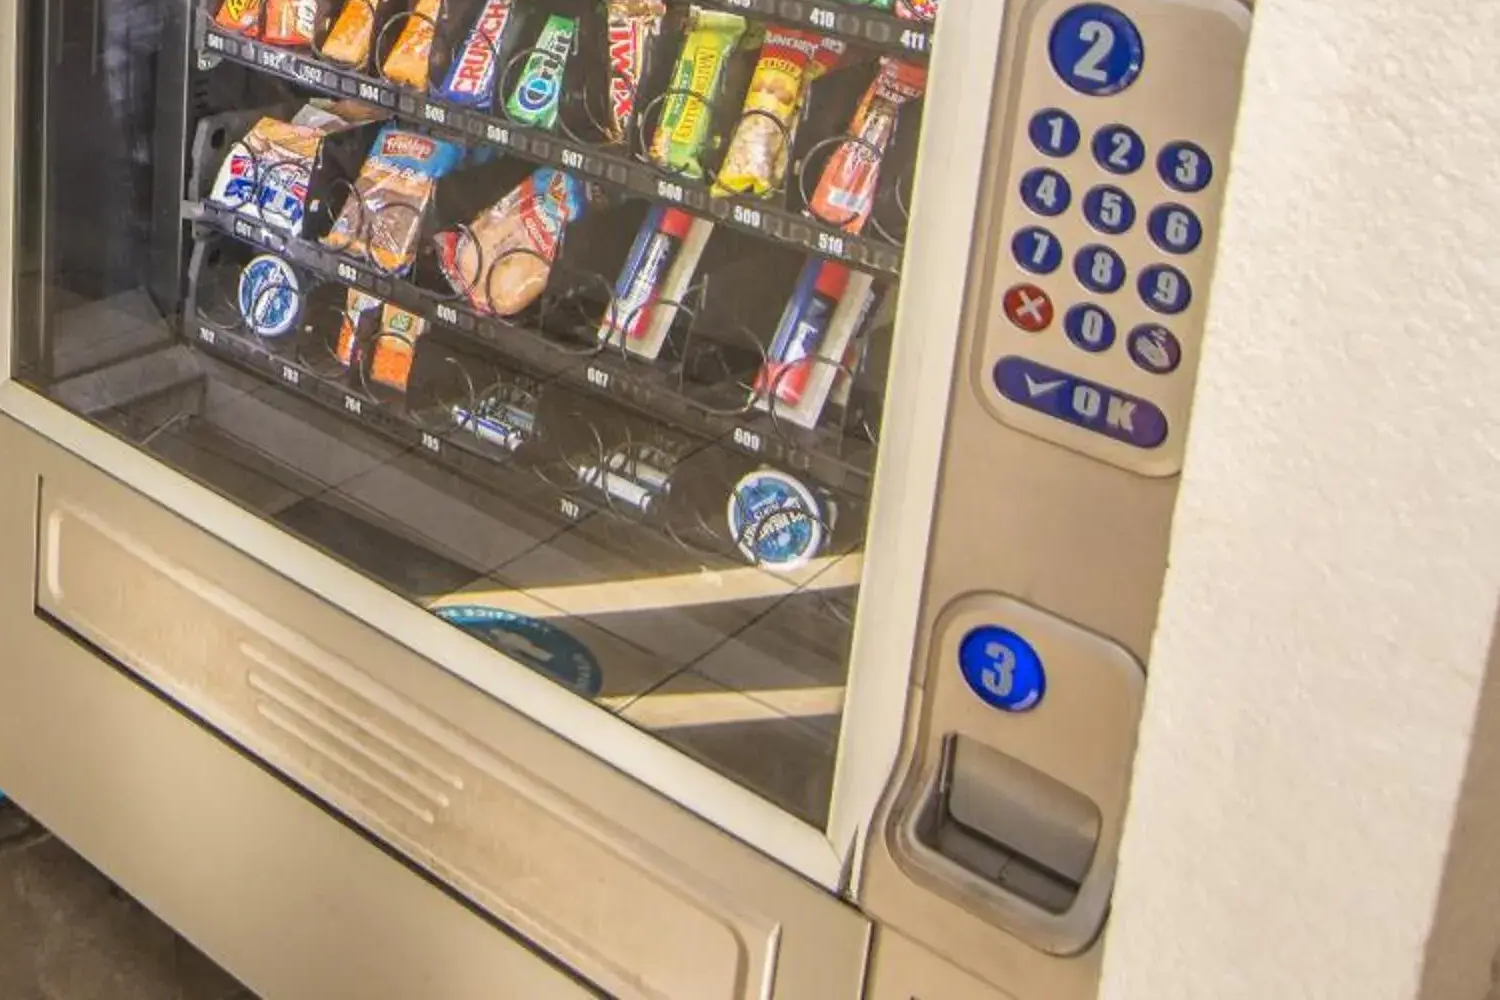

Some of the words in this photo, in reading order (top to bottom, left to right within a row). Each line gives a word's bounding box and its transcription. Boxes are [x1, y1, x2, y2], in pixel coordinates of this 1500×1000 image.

[809, 8, 836, 28] 410
[900, 31, 925, 51] 411
[1072, 20, 1116, 83] 2
[425, 104, 446, 123] 505
[562, 149, 584, 169] 507
[1048, 117, 1065, 149] 1
[1109, 132, 1134, 167] 2
[1175, 149, 1200, 185] 3
[734, 205, 761, 227] 509
[1035, 175, 1058, 209] 4
[1099, 192, 1124, 226] 5
[1165, 210, 1190, 246] 6
[818, 233, 844, 255] 510
[1032, 231, 1050, 265] 7
[1091, 250, 1115, 286] 8
[1152, 270, 1180, 306] 9
[1080, 309, 1104, 343] 0
[1072, 384, 1137, 434] OK
[981, 640, 1017, 697] 3
